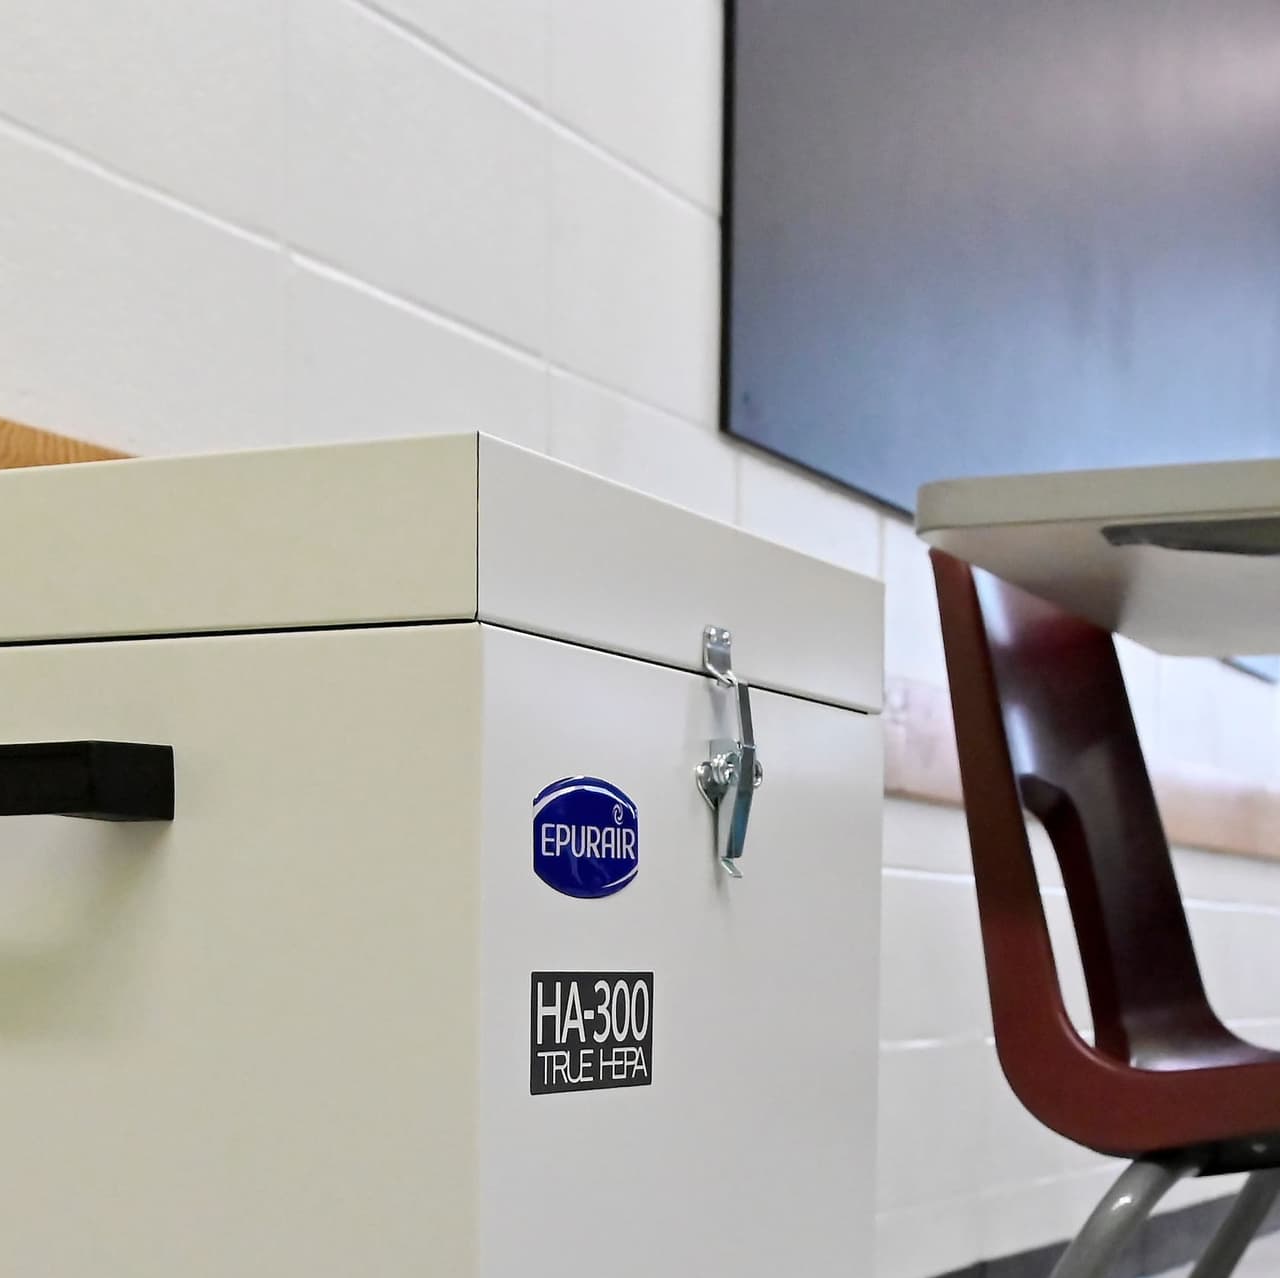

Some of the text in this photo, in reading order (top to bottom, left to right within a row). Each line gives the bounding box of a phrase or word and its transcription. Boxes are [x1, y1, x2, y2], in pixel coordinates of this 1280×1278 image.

[541, 823, 637, 860] EPURAIR
[536, 979, 650, 1045] HA-300
[537, 1047, 648, 1085] TRUE HEPA
